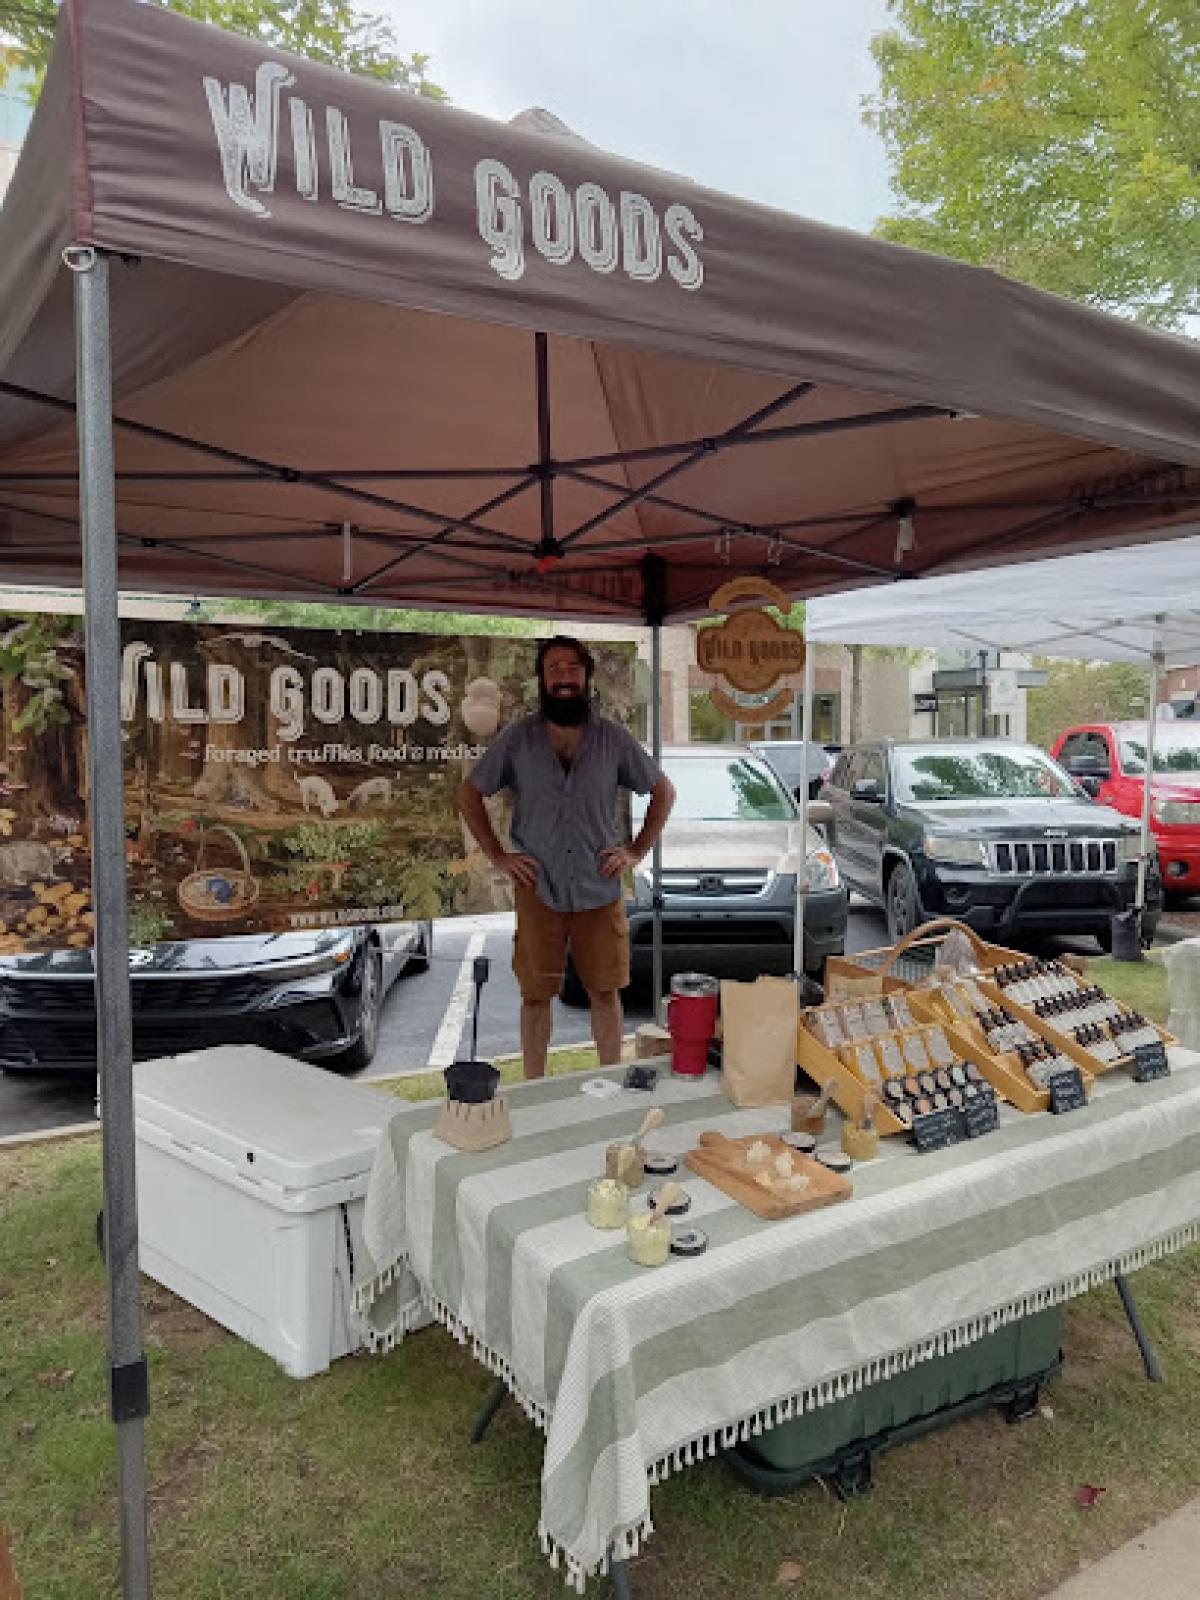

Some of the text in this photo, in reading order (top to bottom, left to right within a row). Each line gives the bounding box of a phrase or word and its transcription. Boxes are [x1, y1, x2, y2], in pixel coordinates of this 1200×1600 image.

[203, 61, 704, 290] WILD GOODS
[270, 665, 451, 741] GOODS
